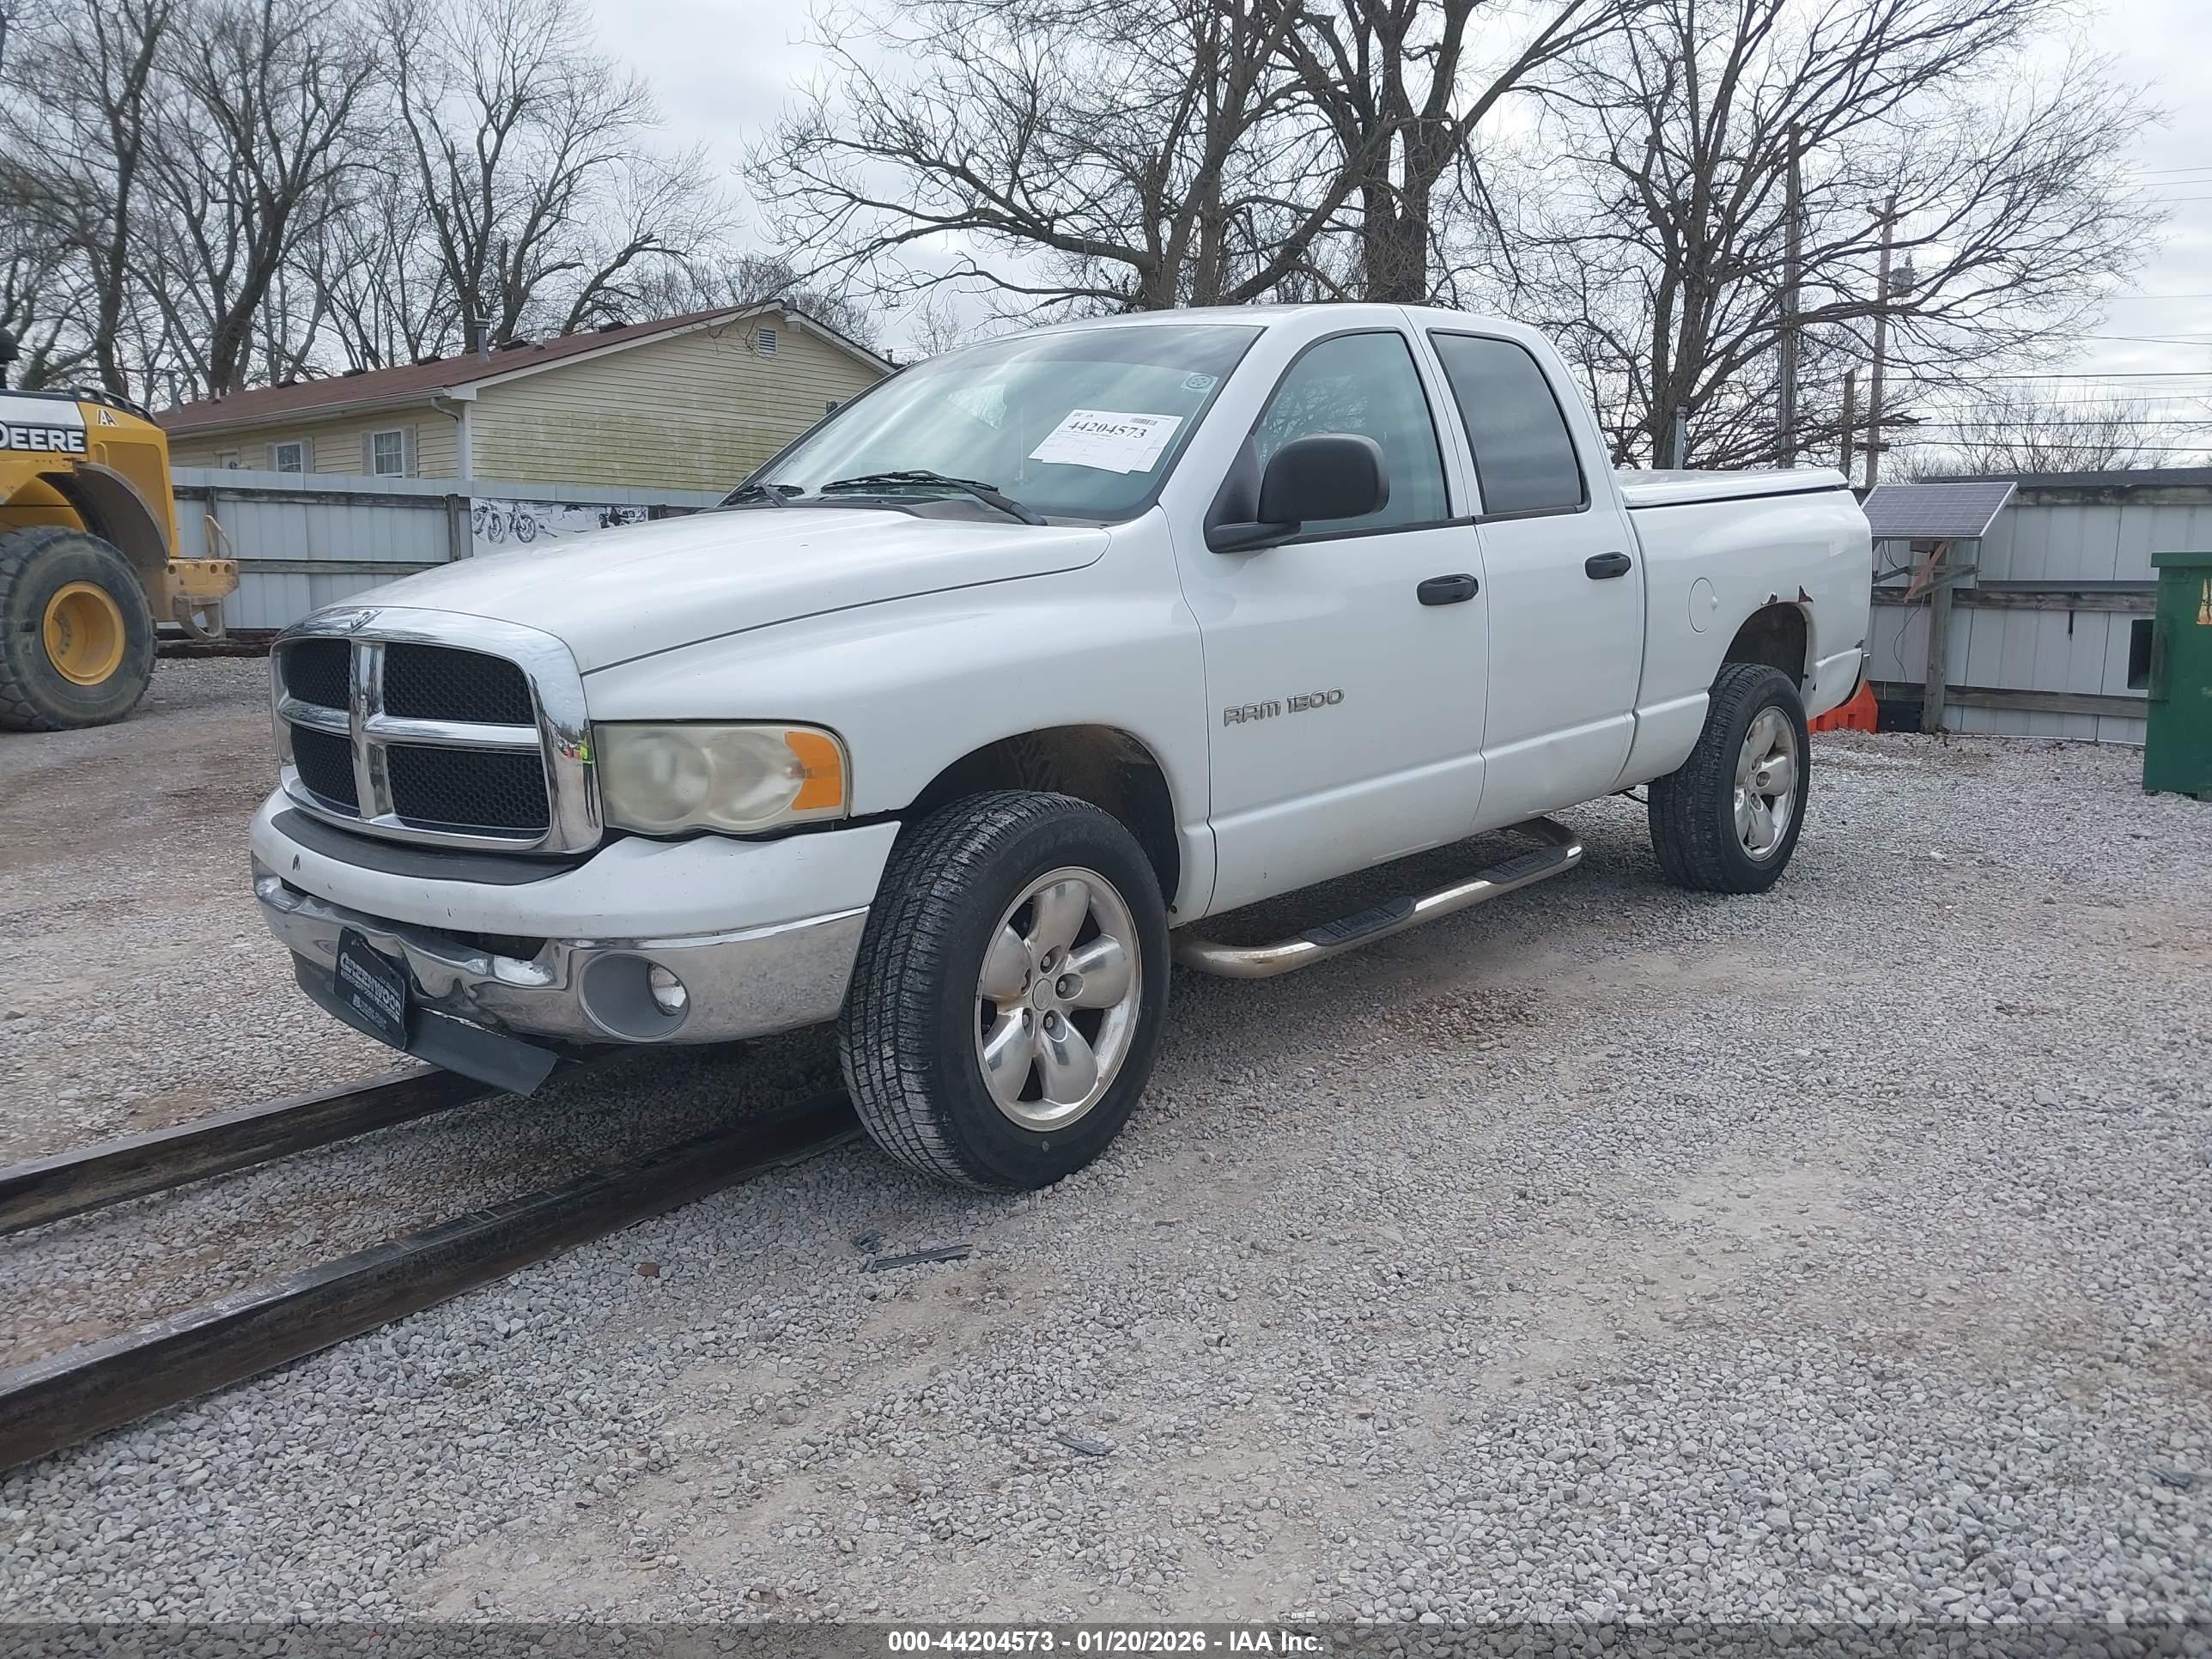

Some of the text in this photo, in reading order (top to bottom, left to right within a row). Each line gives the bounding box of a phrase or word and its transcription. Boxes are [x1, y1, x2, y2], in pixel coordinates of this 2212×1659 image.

[1068, 421, 1147, 439] 44204573
[1224, 687, 1345, 726] RAM 1500
